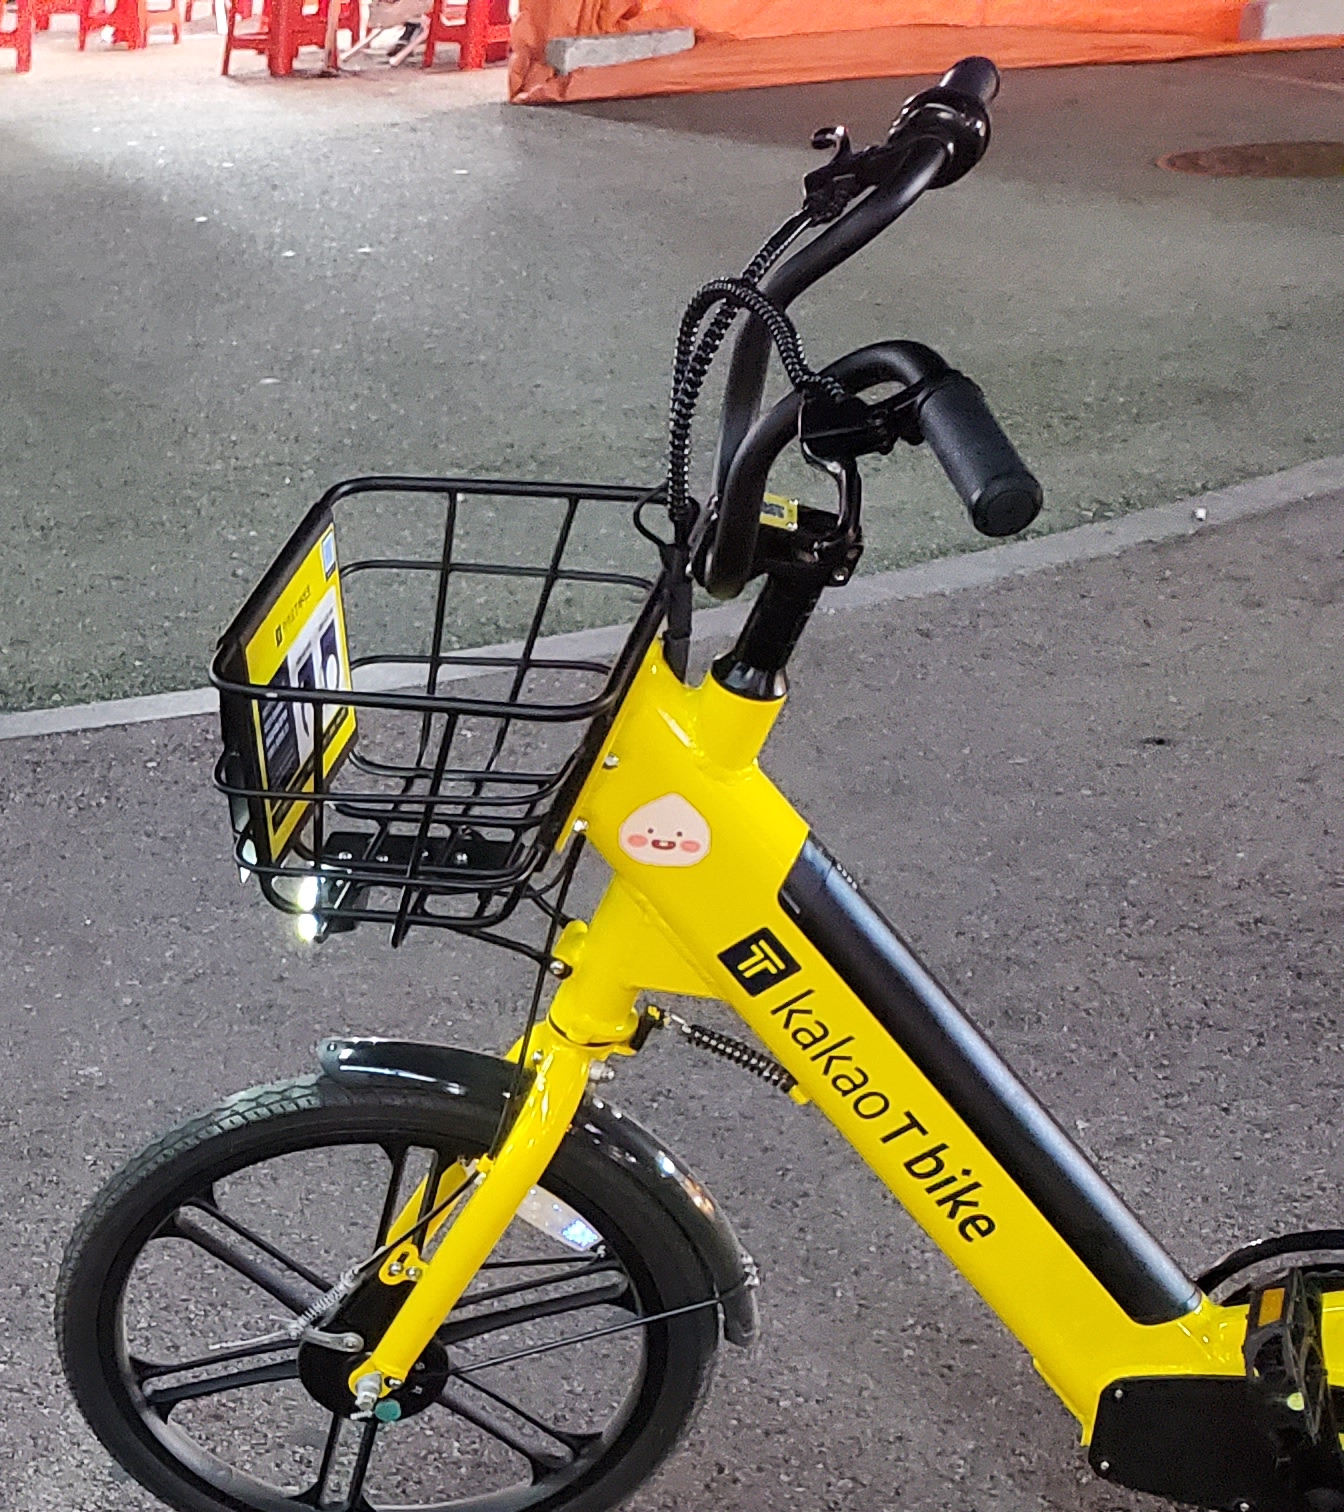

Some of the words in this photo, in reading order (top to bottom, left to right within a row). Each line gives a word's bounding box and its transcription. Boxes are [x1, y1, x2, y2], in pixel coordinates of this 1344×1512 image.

[770, 989, 890, 1120] kakao
[880, 1110, 928, 1144] T
[903, 1143, 996, 1243] bike
